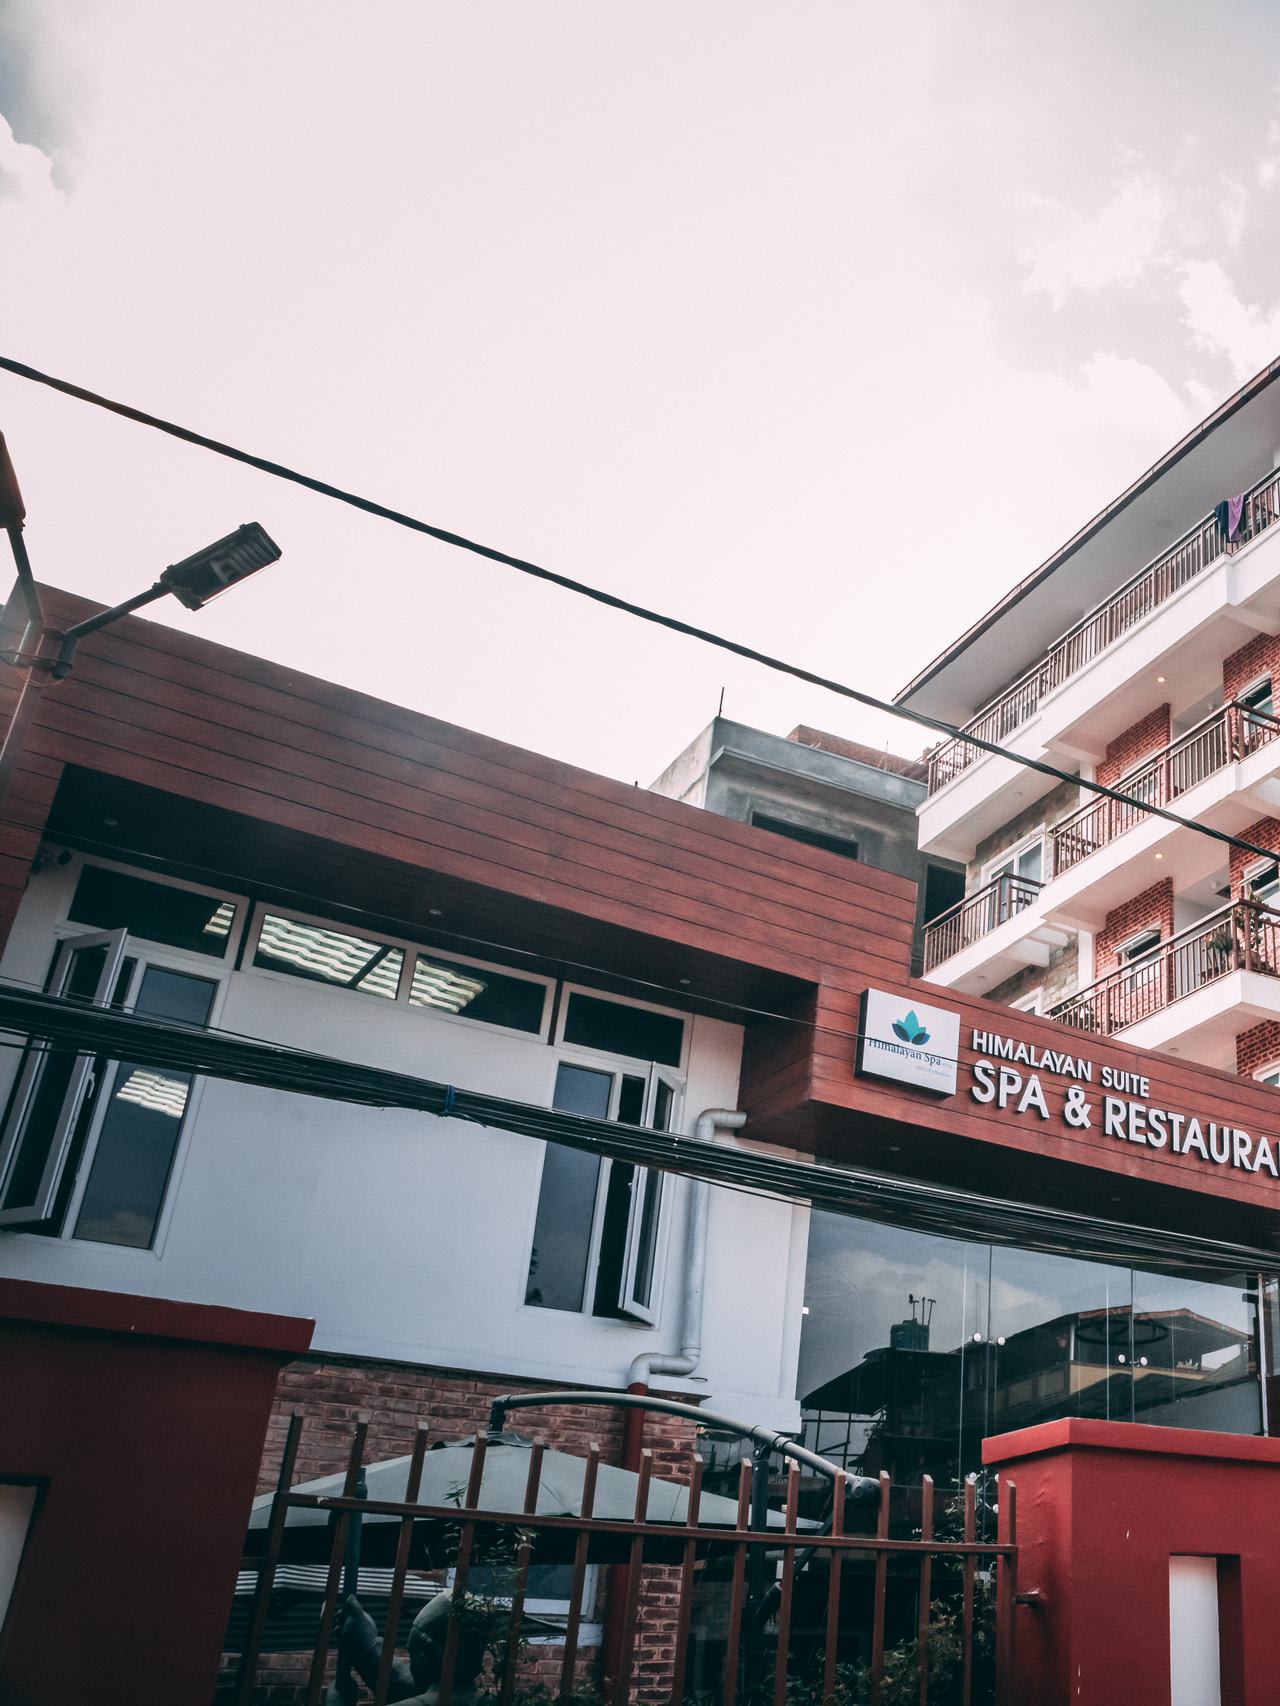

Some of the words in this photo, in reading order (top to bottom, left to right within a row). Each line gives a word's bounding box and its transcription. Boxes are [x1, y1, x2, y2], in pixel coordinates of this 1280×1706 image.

[924, 1052, 941, 1067] Spa
[971, 1059, 1050, 1119] SPA
[1064, 1085, 1091, 1129] &
[972, 1029, 1092, 1082] HIMALAYAN
[1101, 1066, 1150, 1098] SUITE
